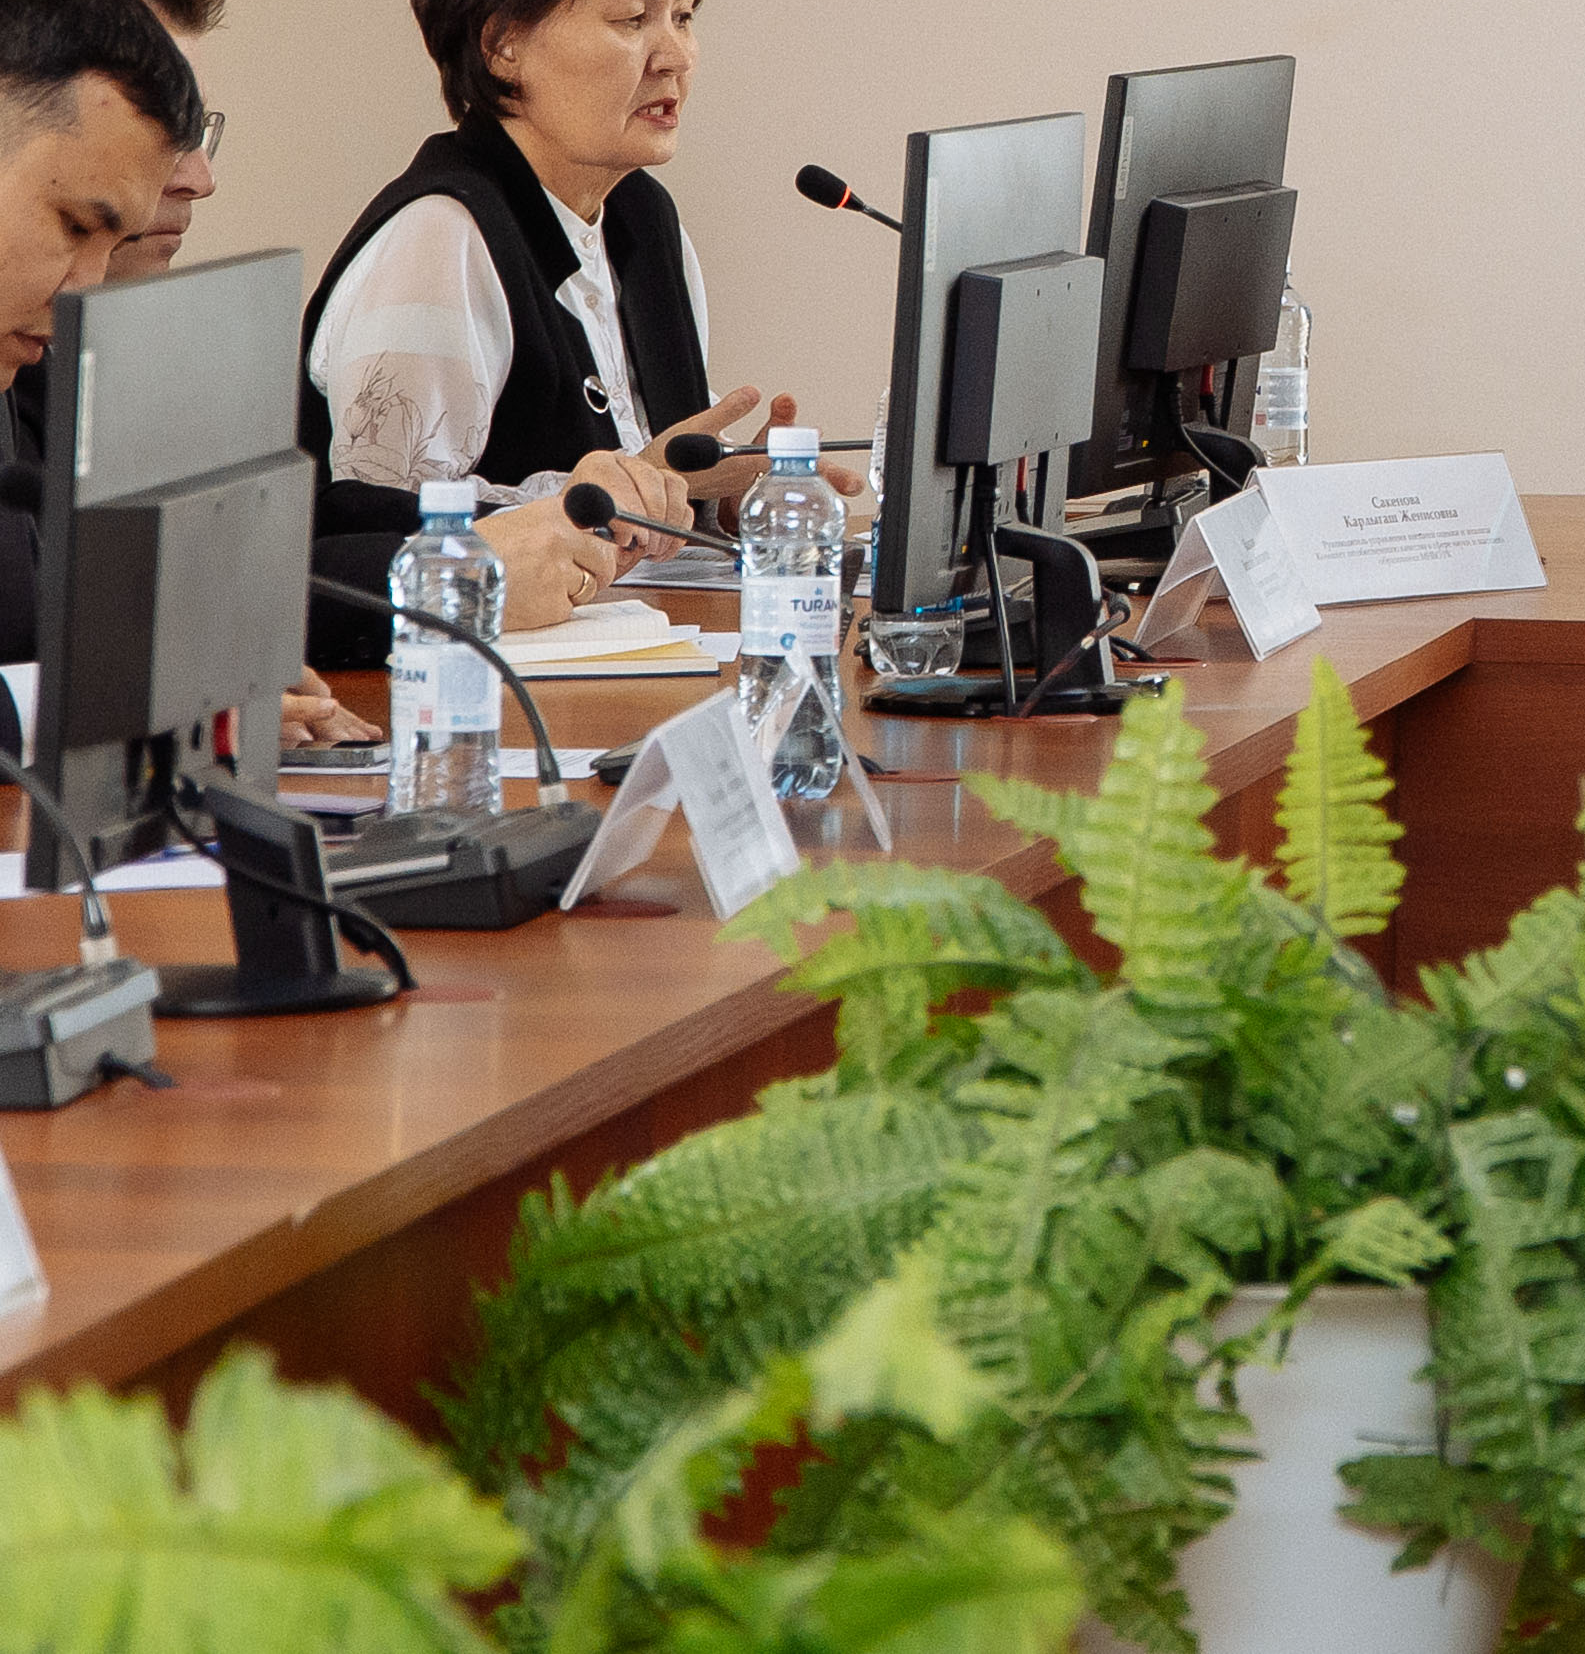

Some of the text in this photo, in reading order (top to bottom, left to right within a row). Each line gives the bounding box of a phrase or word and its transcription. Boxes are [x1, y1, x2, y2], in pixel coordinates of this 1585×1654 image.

[1371, 494, 1421, 509] Сакенова
[1343, 507, 1458, 530] Карлыгаш Женисовна
